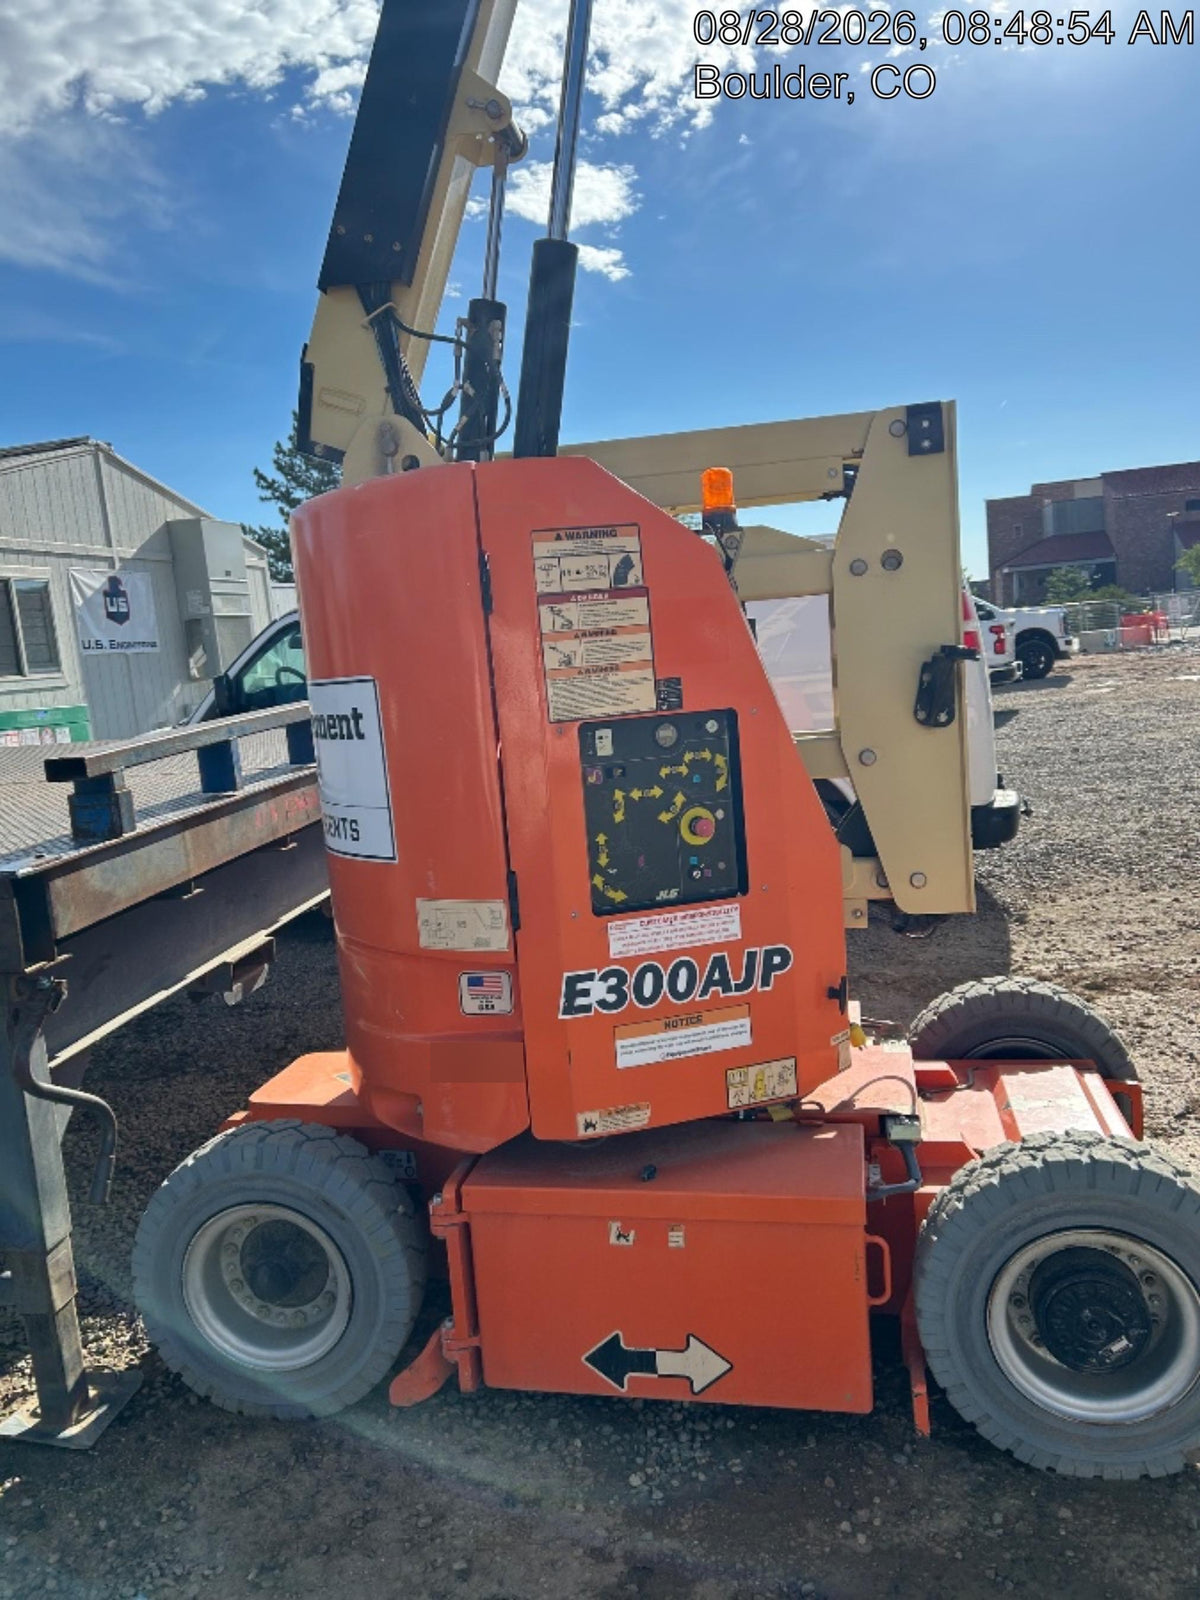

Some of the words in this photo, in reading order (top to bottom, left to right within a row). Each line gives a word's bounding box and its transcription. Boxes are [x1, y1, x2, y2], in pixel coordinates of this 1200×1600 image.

[565, 529, 617, 541] WARNING
[105, 596, 129, 613] US
[81, 639, 107, 650] U.S.
[559, 945, 793, 1019] E300AJP
[664, 1014, 703, 1030] NOTICE
